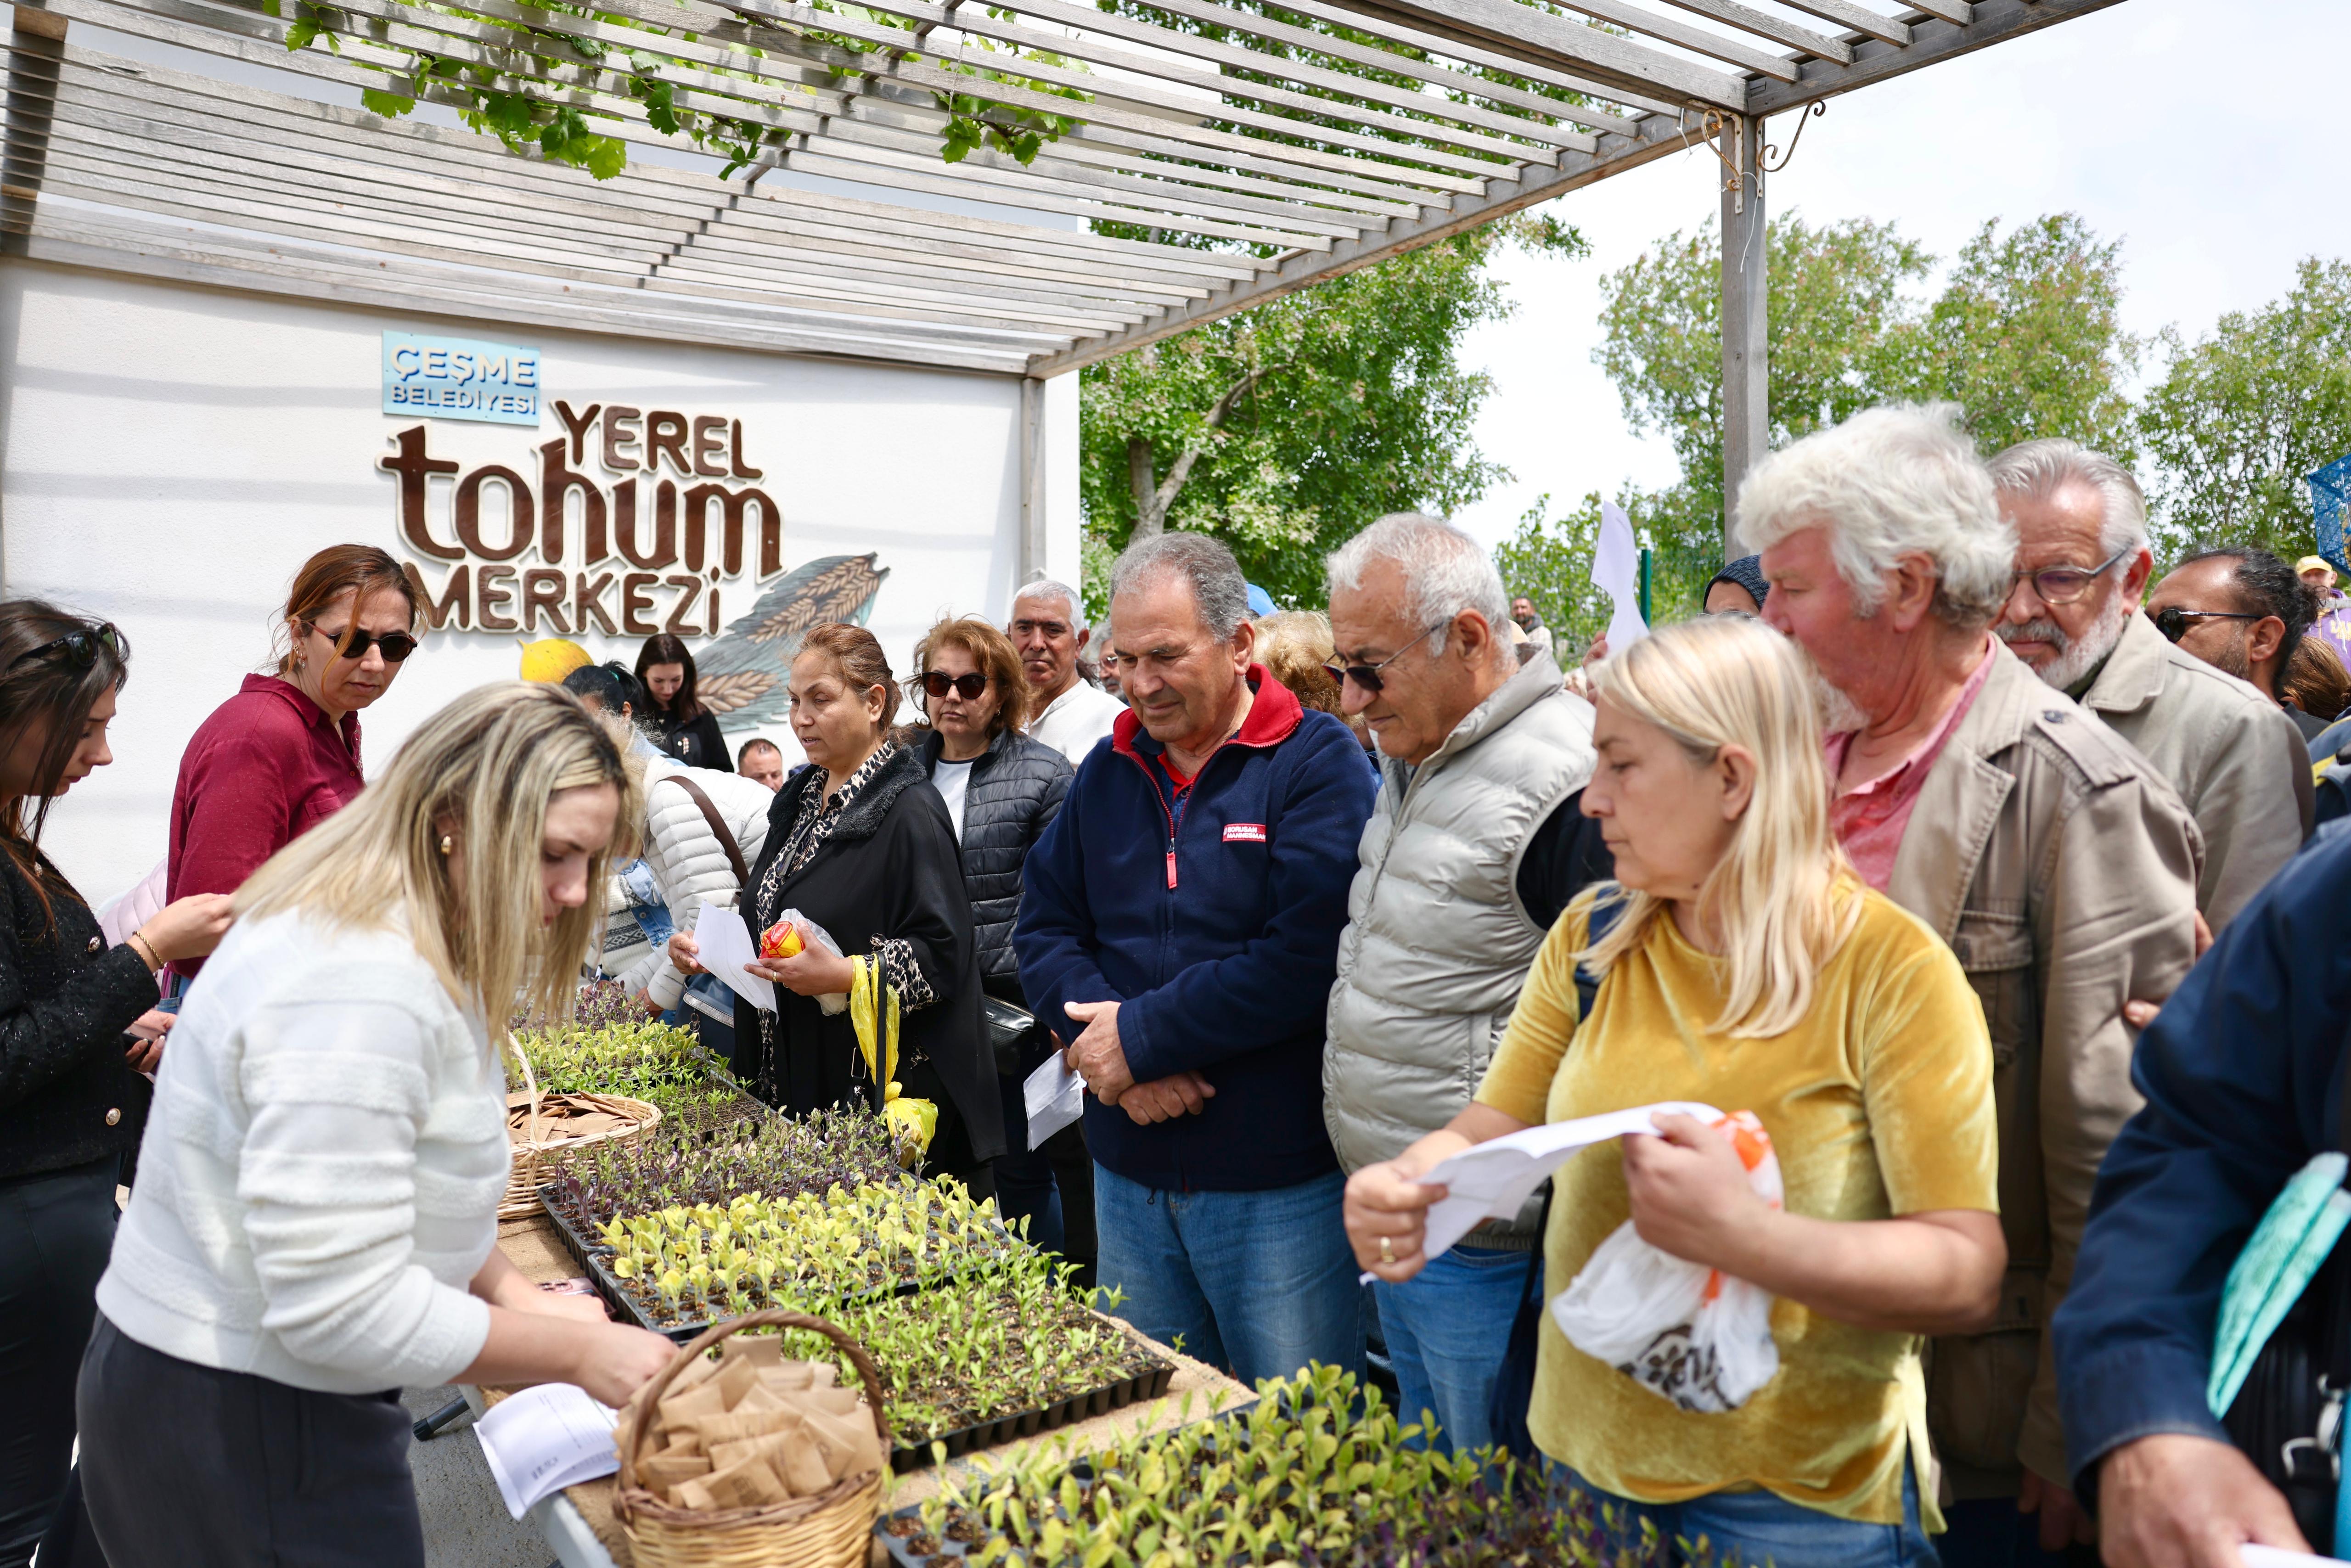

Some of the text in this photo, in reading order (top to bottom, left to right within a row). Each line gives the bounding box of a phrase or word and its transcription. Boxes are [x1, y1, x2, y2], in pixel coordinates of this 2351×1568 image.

[390, 344, 535, 387] ÇEŞME
[555, 400, 763, 478] YEREL
[381, 425, 782, 577] tohum
